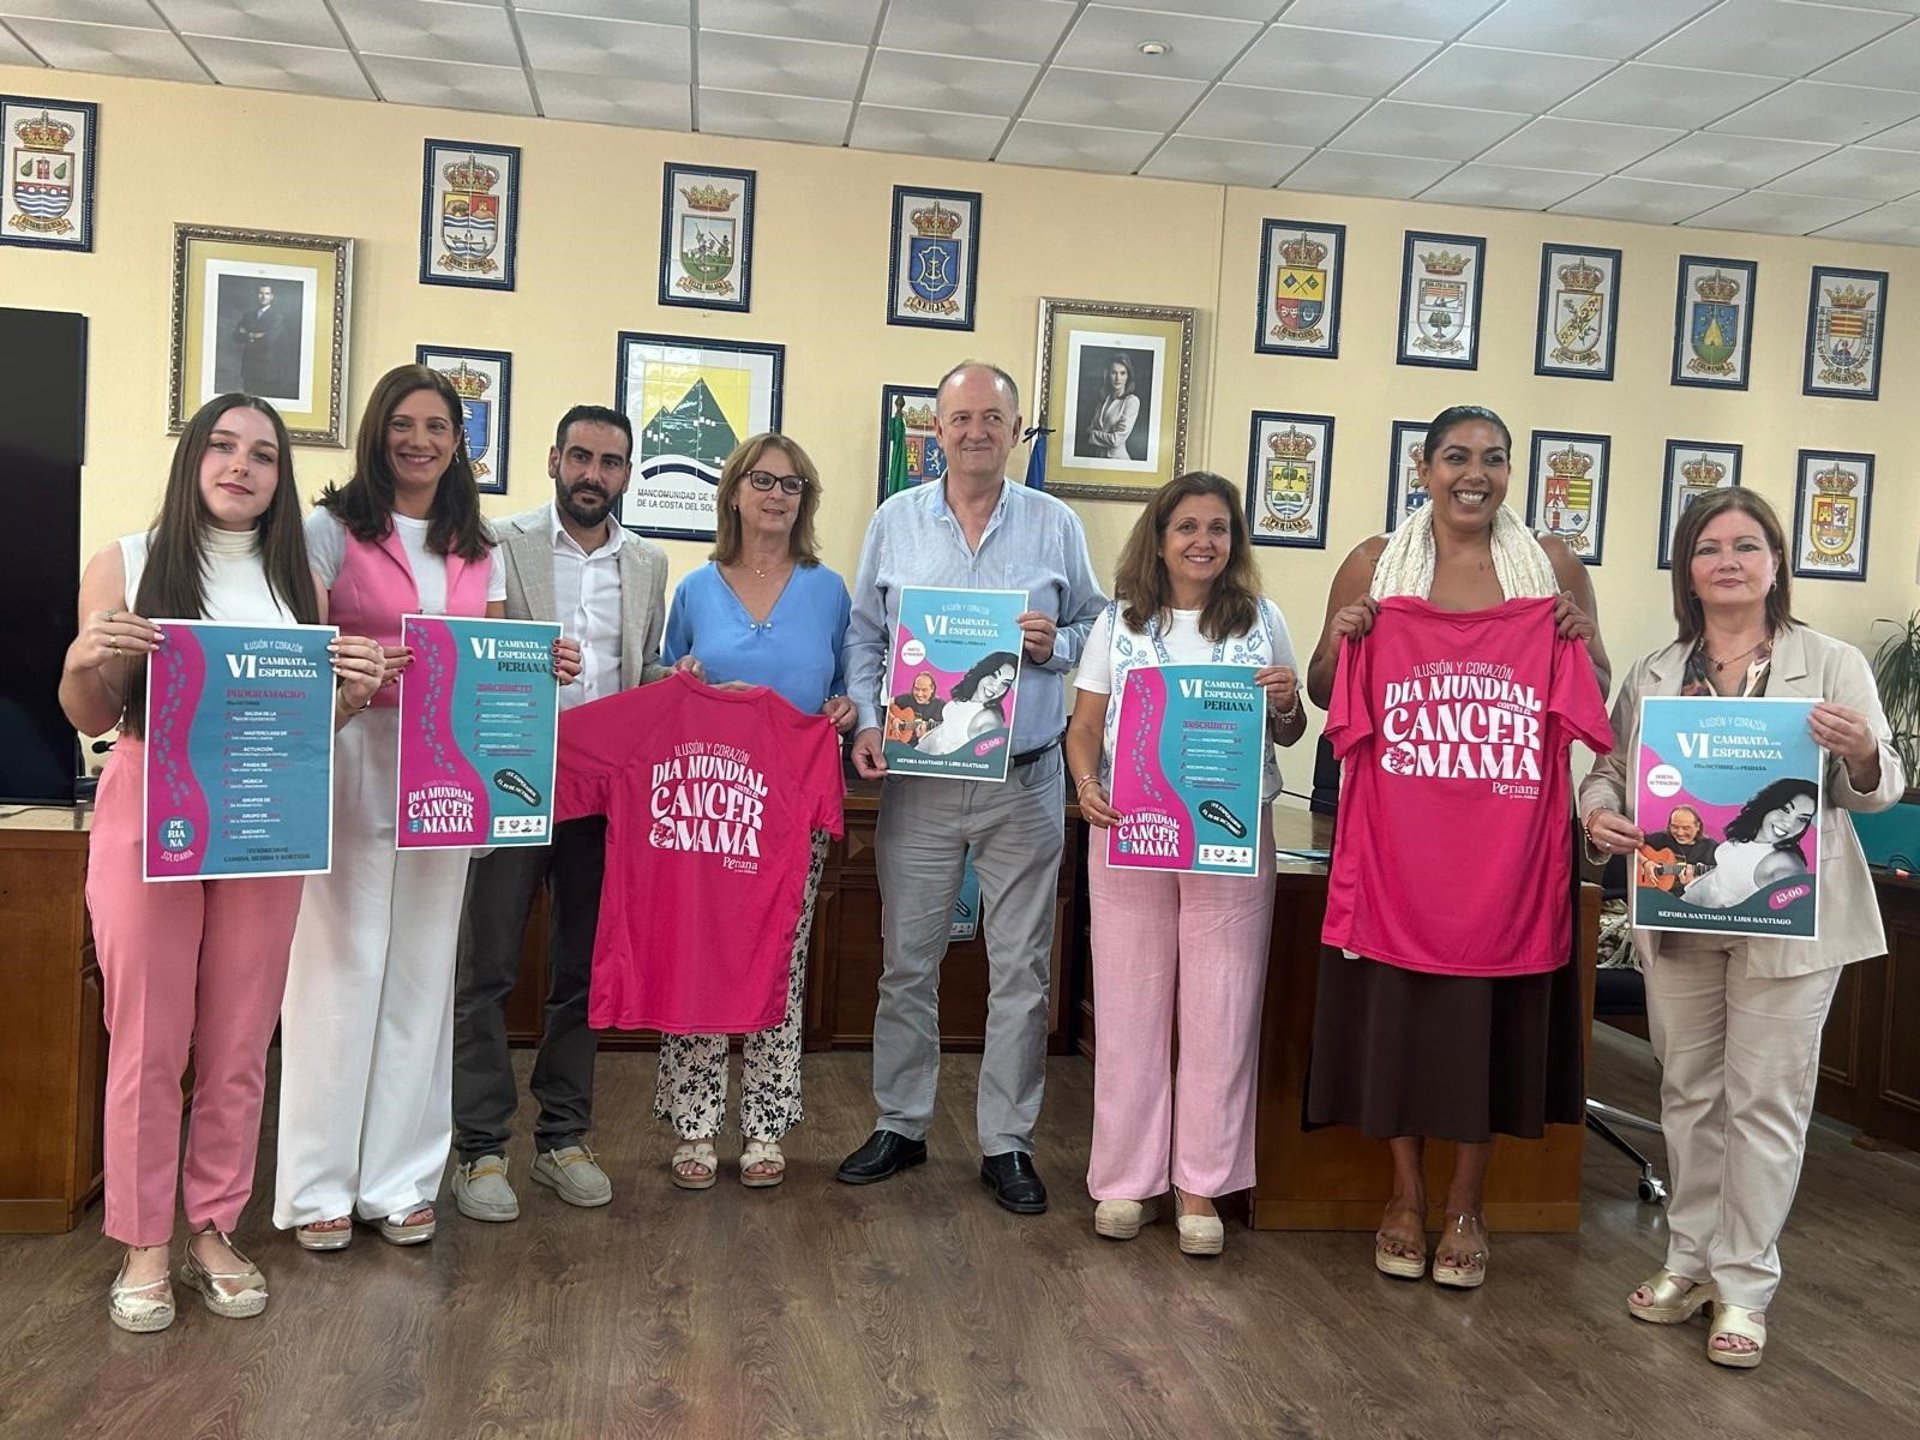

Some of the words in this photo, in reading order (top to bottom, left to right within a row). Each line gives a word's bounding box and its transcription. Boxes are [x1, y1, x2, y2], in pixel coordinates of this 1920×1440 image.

[917, 299, 946, 312] NERJA
[637, 488, 696, 500] MANCOMUNIDAD
[698, 492, 709, 501] DE
[636, 498, 647, 507] DE
[648, 500, 658, 508] LA
[659, 500, 684, 509] COSTA
[684, 502, 699, 511] DEL
[924, 614, 949, 636] VI
[950, 617, 990, 626] CAMINATA
[948, 627, 999, 638] ESPERANZA
[469, 636, 496, 660] VI
[497, 640, 540, 649] CAMINATA
[258, 656, 307, 666] CAMINATA
[497, 650, 549, 660] ESPERANZA
[225, 653, 257, 679] VI
[258, 668, 318, 678] ESPERANZA
[497, 661, 549, 673] PERIANA
[1413, 659, 1453, 679] ILUSIÓN
[1456, 662, 1463, 673] Y
[1465, 661, 1515, 681] CORAZÓN
[1179, 679, 1203, 698] VI
[1204, 680, 1245, 690] CAMINATA
[1204, 690, 1254, 700] ESPERANZA
[1384, 677, 1424, 710] DÍA
[1428, 675, 1542, 713] MUNDIAL
[1203, 700, 1254, 712] PERIANA
[1496, 701, 1523, 713] CONTRA
[1382, 702, 1541, 751] CÁNCER
[1676, 732, 1709, 759] VI
[1713, 735, 1770, 746] CAMINATA
[674, 739, 704, 757] ILUSIÓN
[706, 743, 712, 754] Y
[713, 743, 750, 765] CORAZÓN
[1712, 748, 1783, 760] ESPERANZA
[1415, 742, 1542, 781] MAMA
[651, 756, 682, 791] DÍA
[687, 755, 769, 798] MUNDIAL
[428, 786, 475, 803] MUNDIAL
[1492, 781, 1540, 796] Periana
[651, 780, 765, 832] CÁNCER
[170, 820, 184, 829] PE
[423, 816, 474, 834] MAMA
[1136, 812, 1180, 830] MUNDIAL
[167, 829, 186, 838] RIA
[674, 818, 761, 858] MAMA
[169, 838, 184, 847] NA
[1131, 840, 1180, 857] MAMA
[722, 856, 758, 871] Periana
[1775, 886, 1803, 904] 13:00
[1687, 912, 1727, 921] SANTIAGO
[1734, 915, 1751, 923] LUIS
[1753, 916, 1792, 925] SANTIAGO
